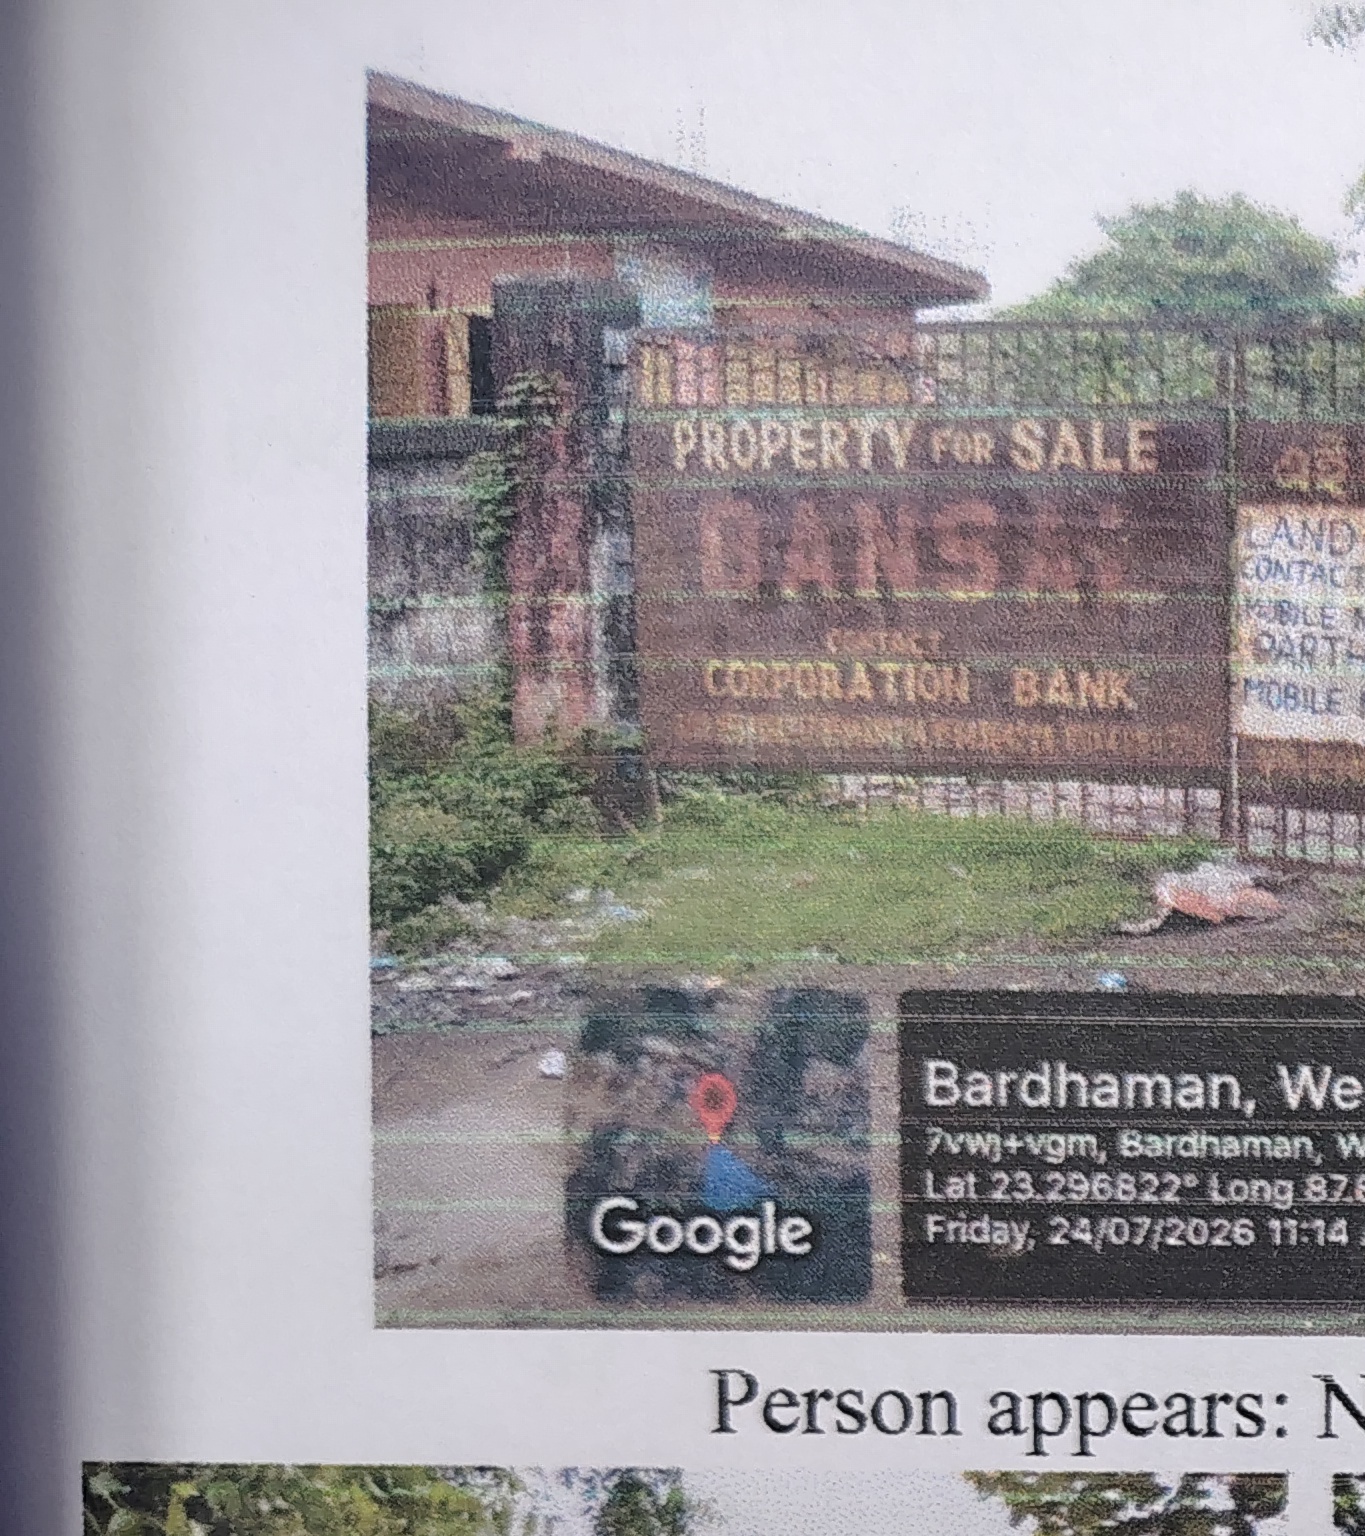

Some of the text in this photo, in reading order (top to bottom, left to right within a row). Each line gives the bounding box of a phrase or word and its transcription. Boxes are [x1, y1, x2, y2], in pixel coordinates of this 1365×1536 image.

[673, 416, 1160, 475] PROPERTY FOR SALE
[1242, 516, 1357, 556] LAND
[1241, 554, 1364, 589] CONTACT
[706, 659, 1139, 710] CORPORATION BANK
[1242, 677, 1343, 716] MOBILE
[710, 1369, 960, 1438] Person
[985, 1385, 1291, 1458] appears:
